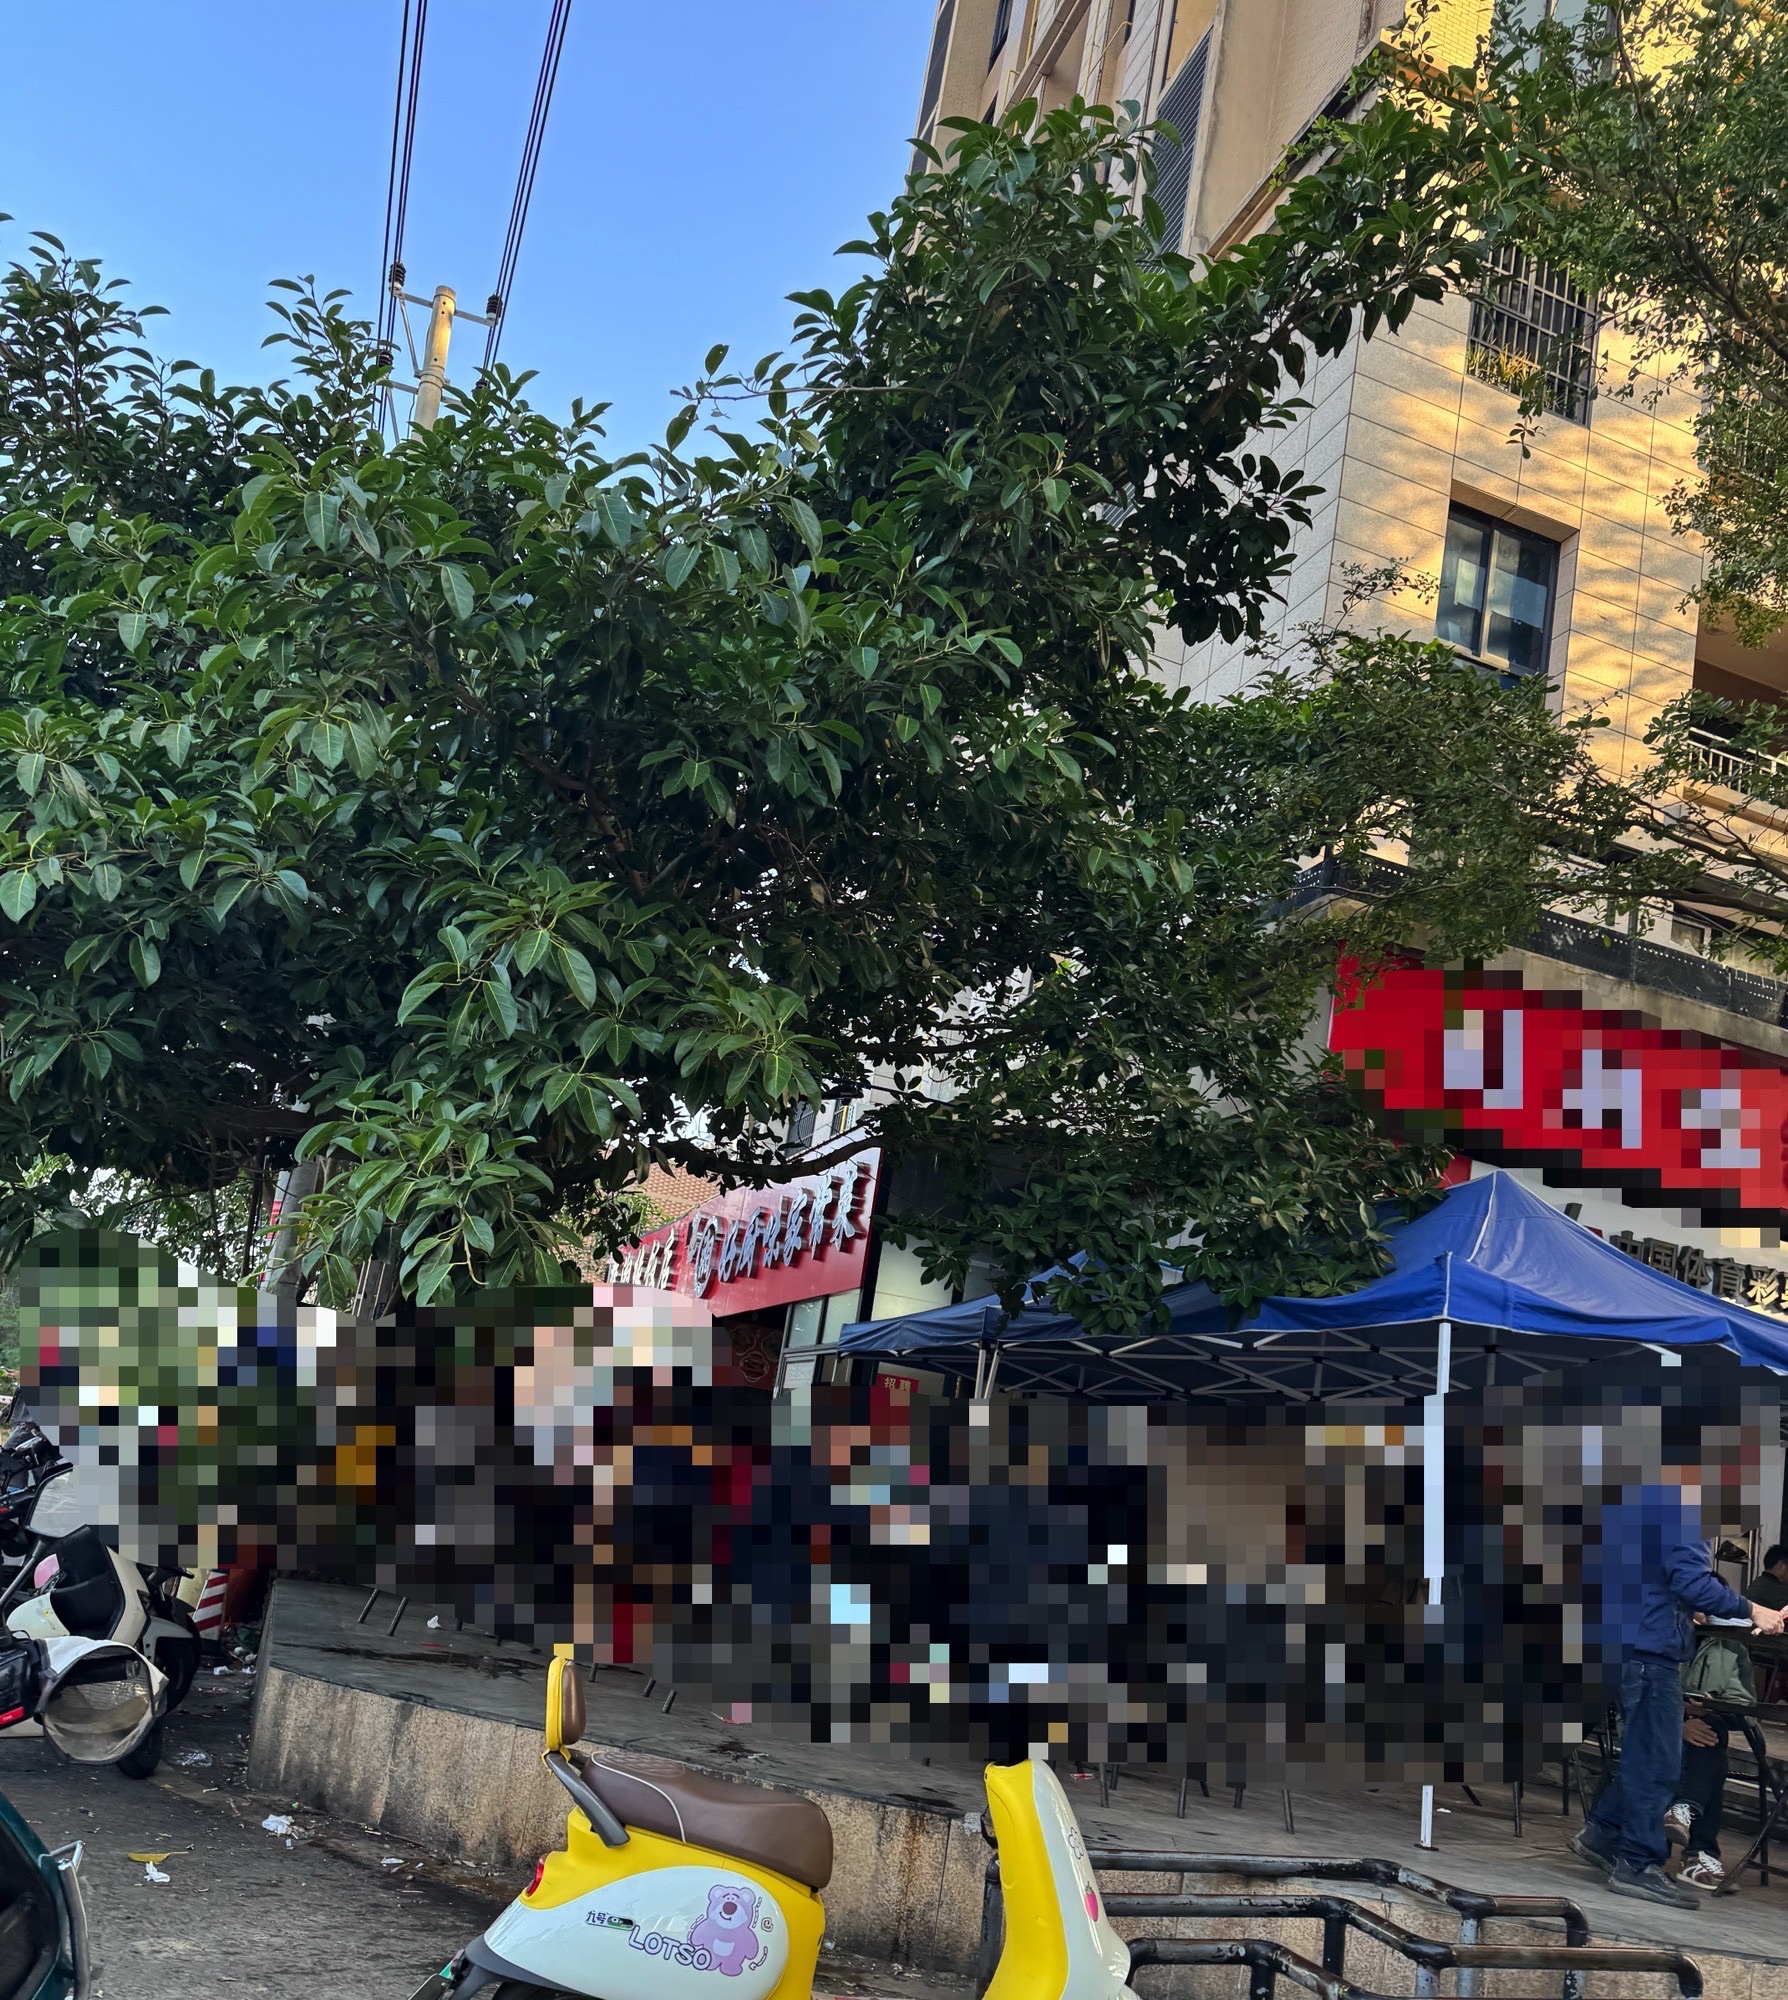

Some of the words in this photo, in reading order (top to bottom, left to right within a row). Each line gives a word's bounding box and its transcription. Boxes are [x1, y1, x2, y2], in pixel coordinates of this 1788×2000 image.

[1610, 1230, 1788, 1310] 中国体育彩
[884, 1377, 911, 1391] 招聘
[586, 1910, 607, 1924] 九号
[629, 1925, 712, 1970] LOTSO
